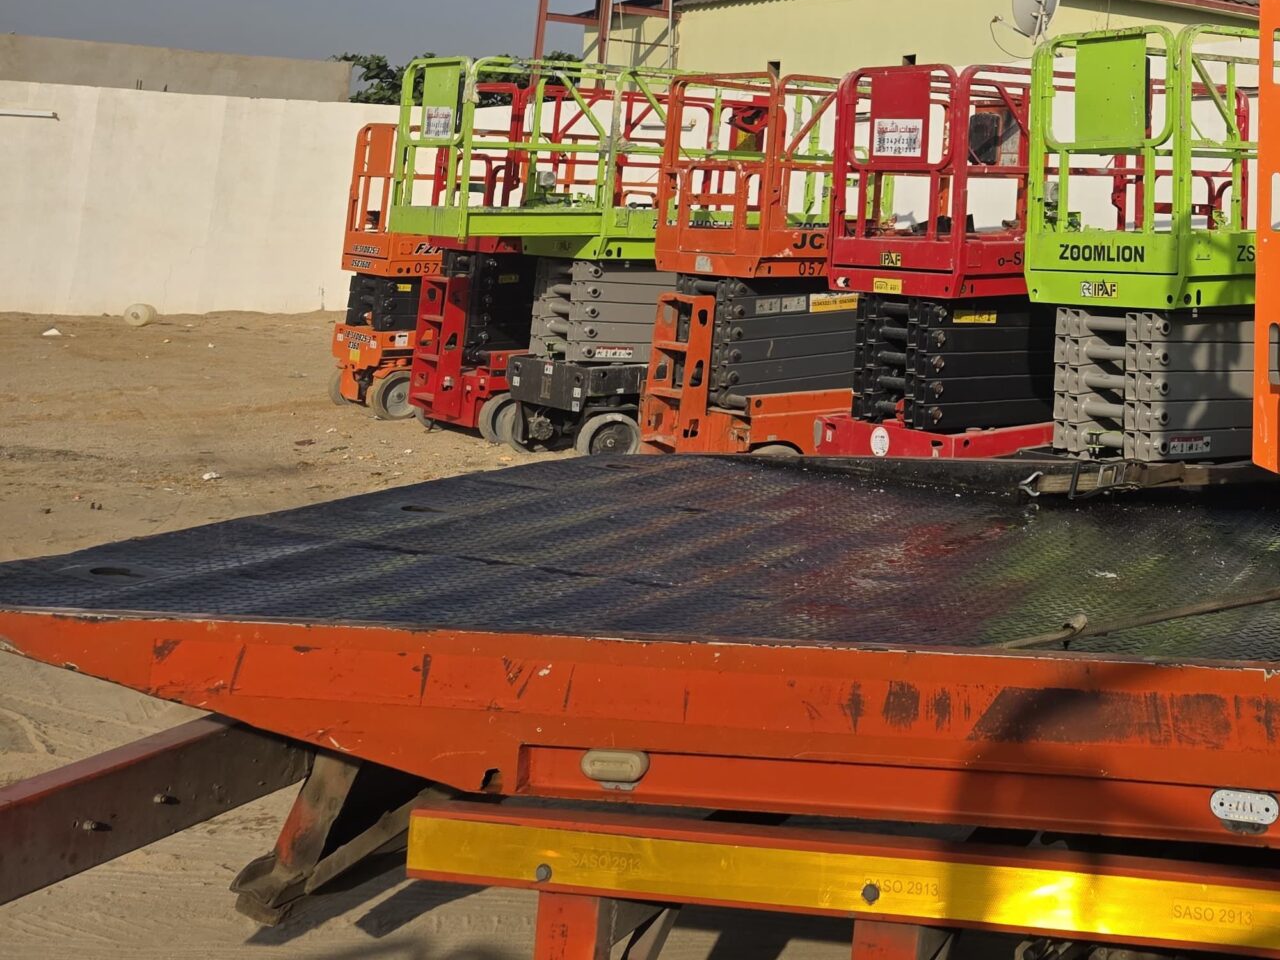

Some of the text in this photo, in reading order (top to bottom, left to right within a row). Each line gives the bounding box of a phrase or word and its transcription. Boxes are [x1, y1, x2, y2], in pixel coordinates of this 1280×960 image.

[880, 250, 902, 267] IPAF
[1059, 243, 1145, 263] ZOOMLION
[415, 262, 439, 274] 057
[798, 262, 824, 276] 057
[1093, 279, 1117, 297] IPAF
[611, 856, 642, 874] 2913
[907, 881, 939, 897] 2913
[1173, 904, 1253, 927] SASO 2913
